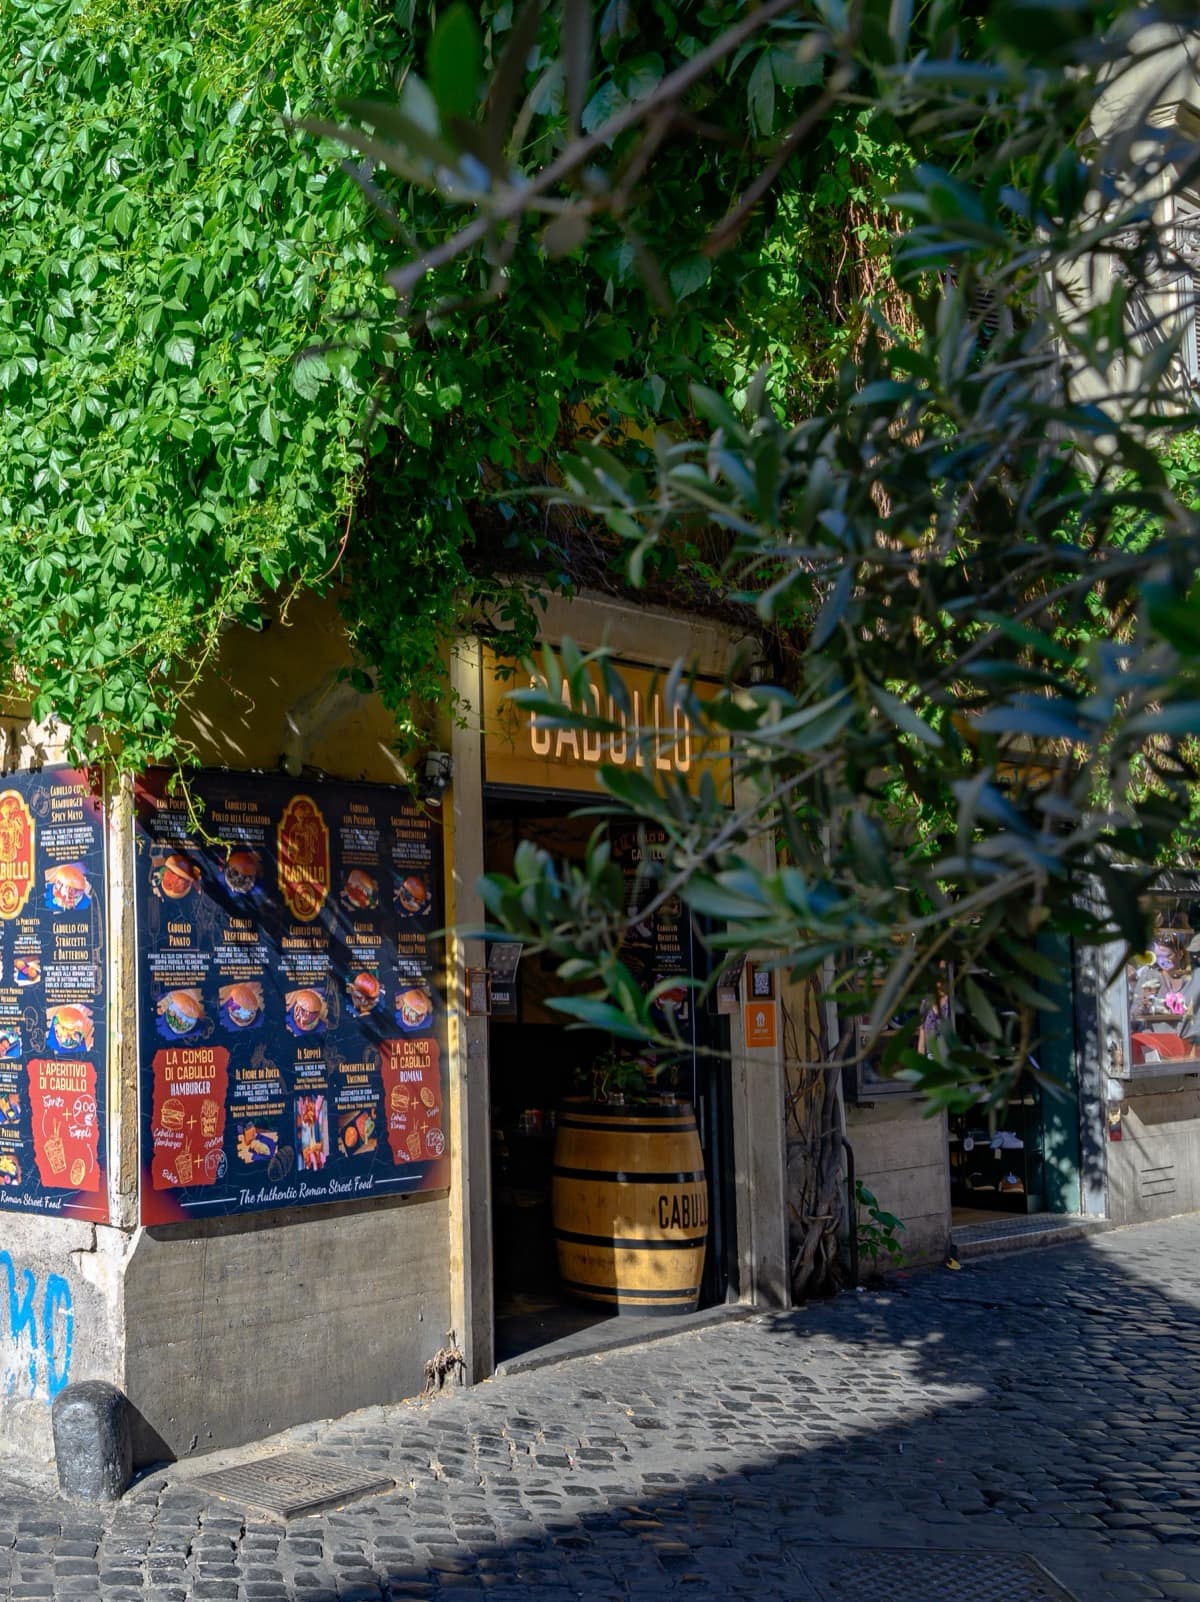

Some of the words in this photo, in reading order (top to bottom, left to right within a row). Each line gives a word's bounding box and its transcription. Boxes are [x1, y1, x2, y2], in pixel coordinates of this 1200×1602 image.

[51, 785, 72, 796] CABULLO
[52, 798, 82, 810] HAMBURGER
[52, 812, 66, 822] SPICY
[68, 810, 84, 822] MAYO
[53, 923, 76, 934] CABULLO
[77, 924, 89, 934] CON
[168, 922, 192, 934] CABULLO
[56, 936, 86, 948] STRACCETTI
[170, 935, 190, 946] PANATO
[224, 930, 259, 942] VEGETARIANO
[59, 950, 89, 960] DATTERINO
[392, 1043, 401, 1056] LA
[404, 1042, 429, 1056] COMBO
[167, 1052, 178, 1066] LA
[183, 1050, 214, 1065] COMBO
[391, 1057, 398, 1070] DI
[400, 1056, 430, 1069] CABULLO
[40, 1063, 86, 1078] L'APERITIVO
[165, 1068, 174, 1080] DI
[178, 1066, 216, 1080] CABULLO
[400, 1071, 423, 1083] ROMANA
[40, 1077, 47, 1090] DI
[50, 1078, 86, 1092] CABULLO
[171, 1082, 211, 1096] HAMBURGER
[240, 1189, 256, 1206] The
[257, 1186, 297, 1204] Authentic
[299, 1183, 328, 1198] Roman
[329, 1179, 352, 1194] Street
[354, 1175, 374, 1192] Food
[1, 1191, 22, 1204] Roman
[23, 1193, 44, 1208] Street
[45, 1196, 62, 1209] Food
